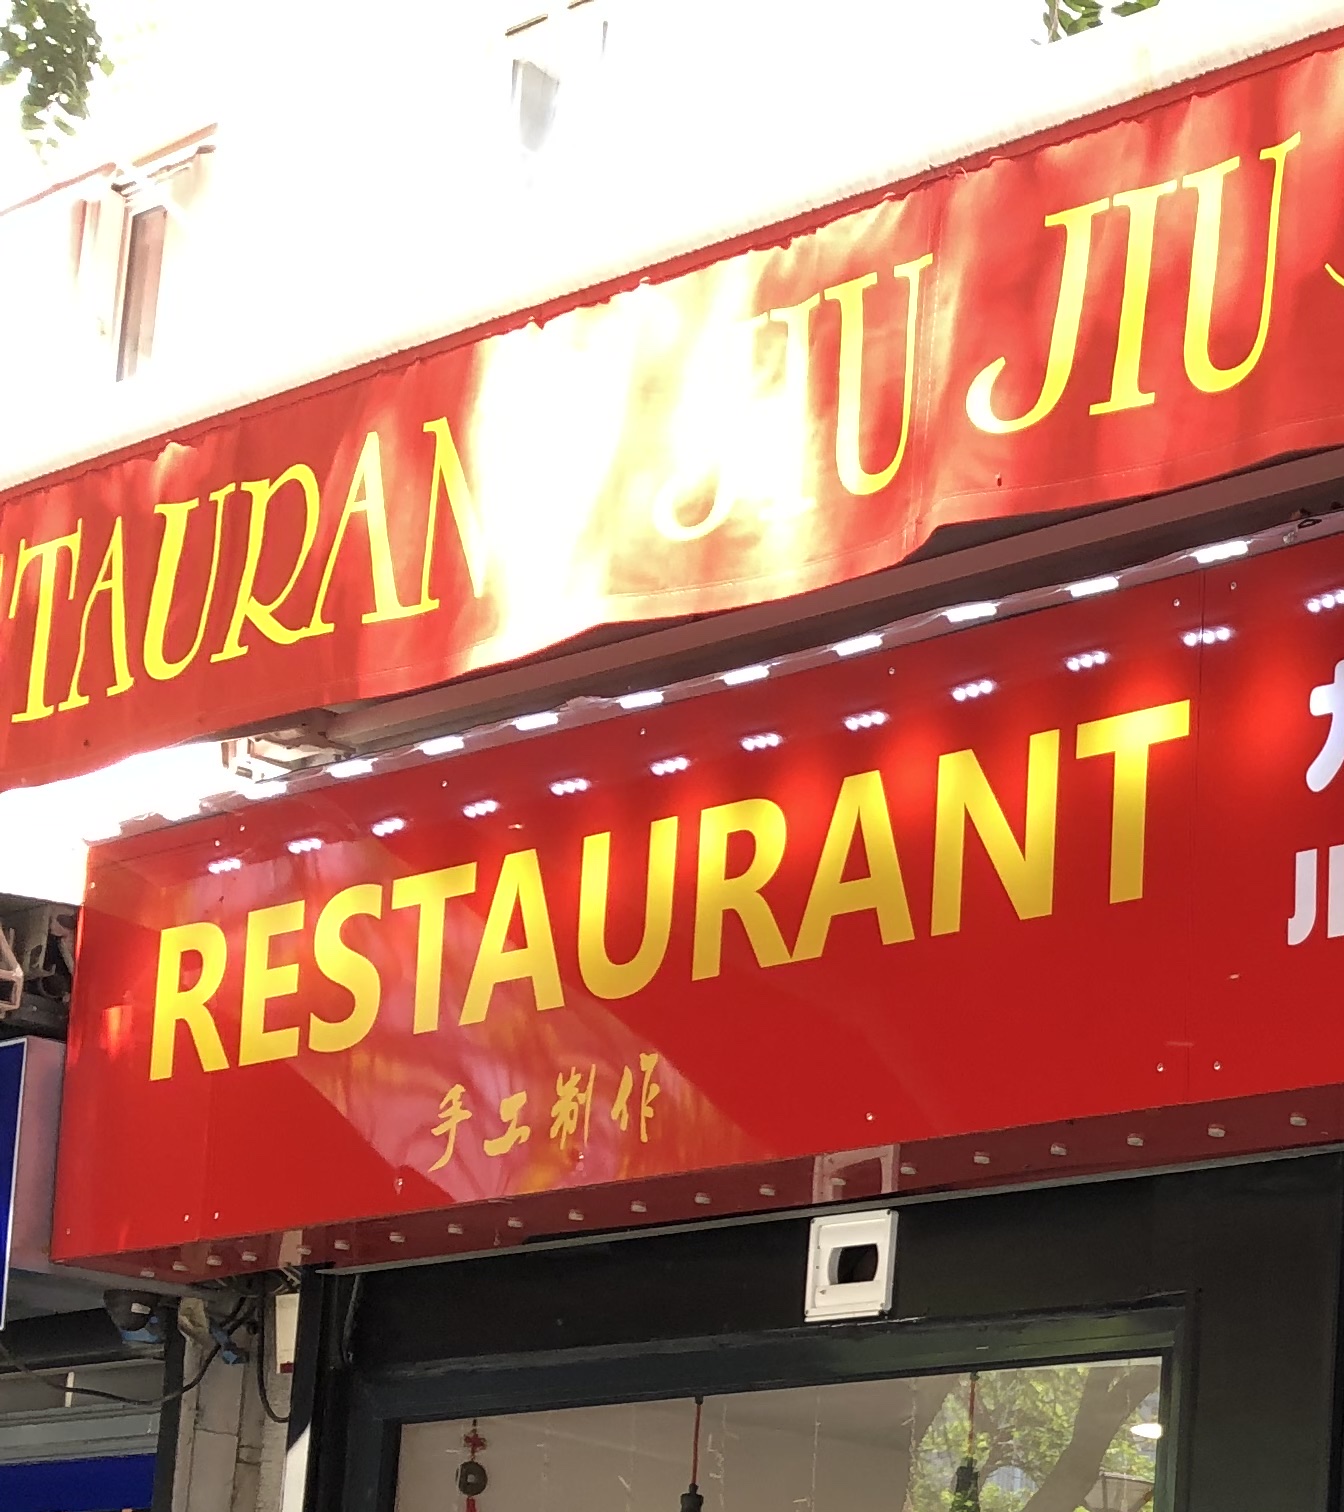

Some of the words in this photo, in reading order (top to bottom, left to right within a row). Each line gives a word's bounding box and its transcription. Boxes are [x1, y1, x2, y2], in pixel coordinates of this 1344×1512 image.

[0, 414, 498, 724] TAURAN
[965, 131, 1301, 436] JIU
[149, 699, 1192, 1082] RESTAURANT
[429, 1053, 659, 1172] 手工制作
